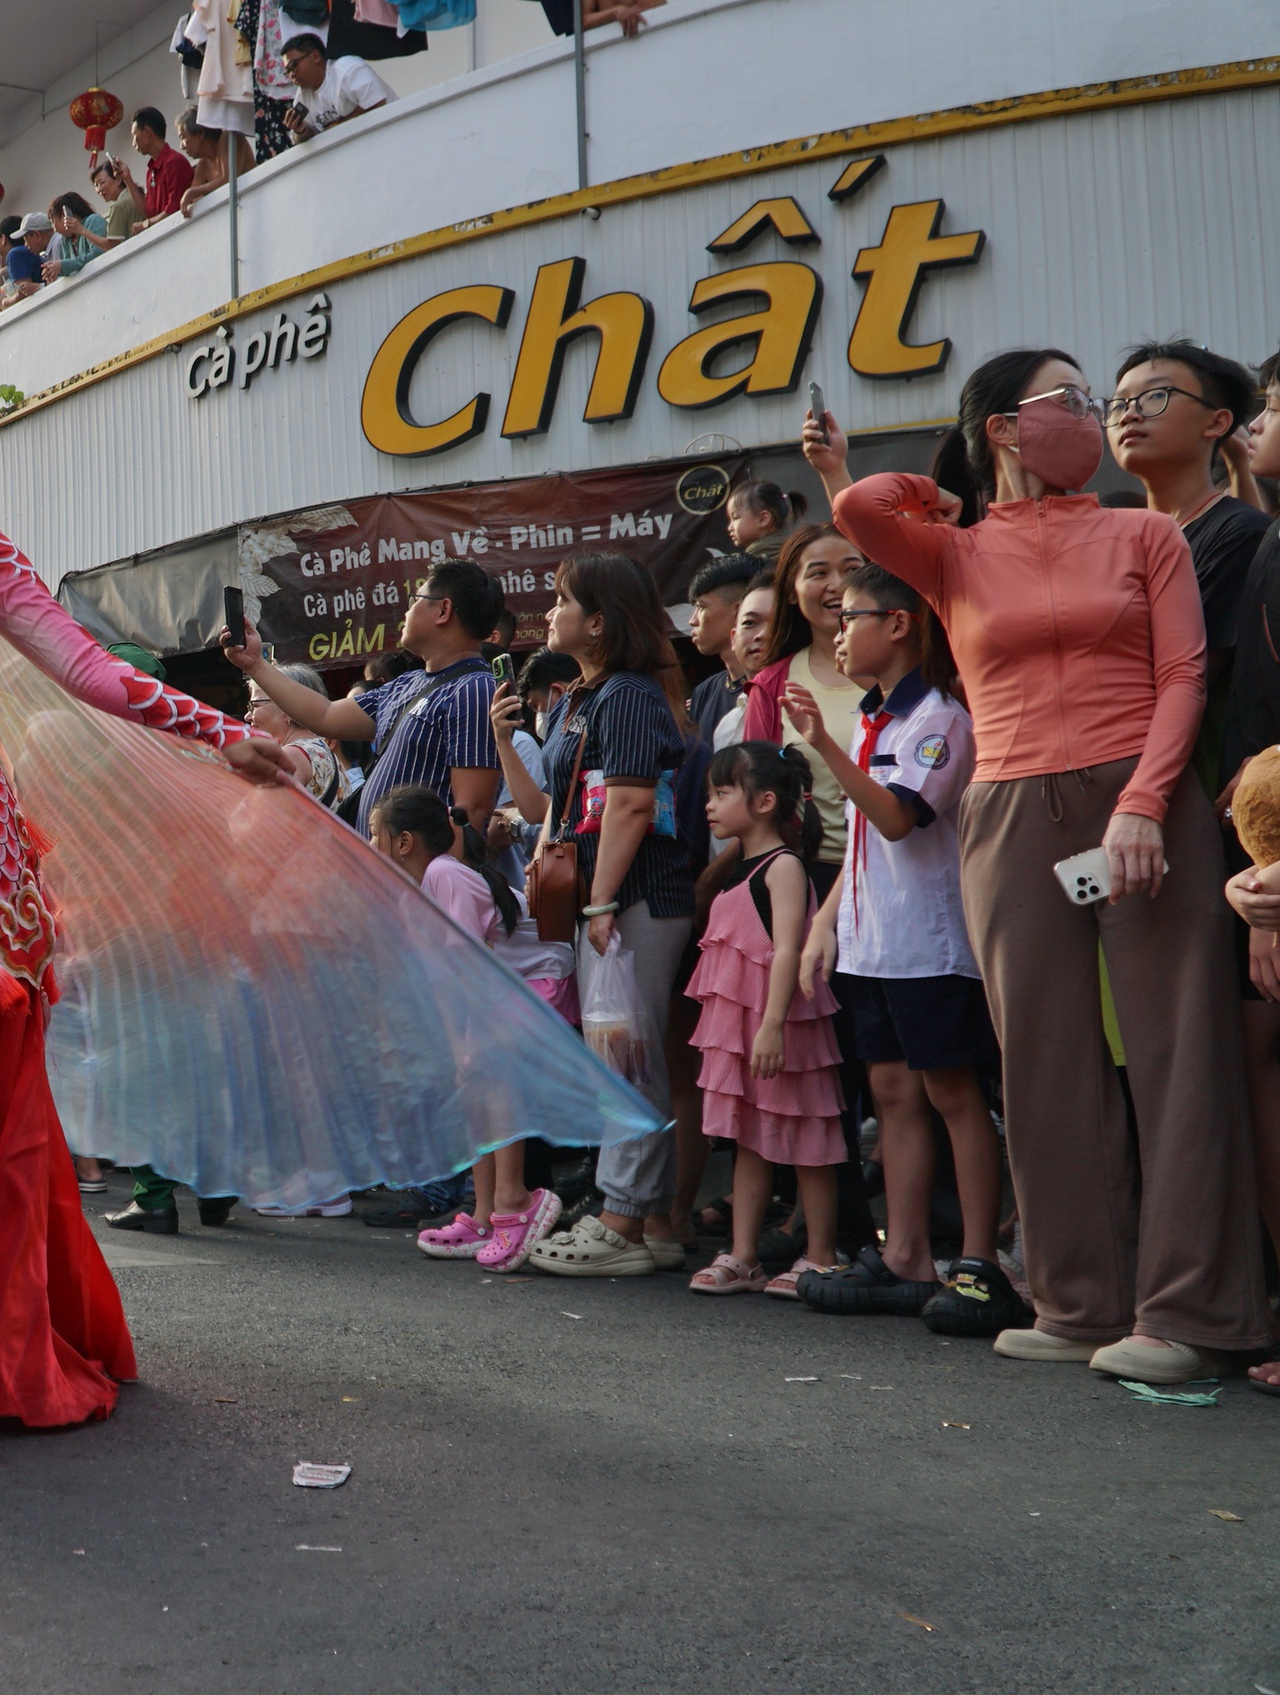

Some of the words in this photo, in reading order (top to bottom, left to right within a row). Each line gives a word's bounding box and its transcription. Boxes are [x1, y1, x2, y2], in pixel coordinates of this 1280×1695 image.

[184, 325, 233, 398] Cà
[239, 292, 331, 389] phê
[361, 154, 987, 458] Chất
[300, 552, 325, 577] Cà
[330, 541, 371, 572] Phê
[378, 537, 447, 564] Mang
[451, 525, 489, 556] Về
[510, 524, 574, 551] Phin
[609, 509, 673, 541] Máy
[303, 593, 328, 618] Cà
[333, 586, 366, 618] phê
[372, 580, 400, 606] đá
[308, 618, 386, 661] GIẢM
